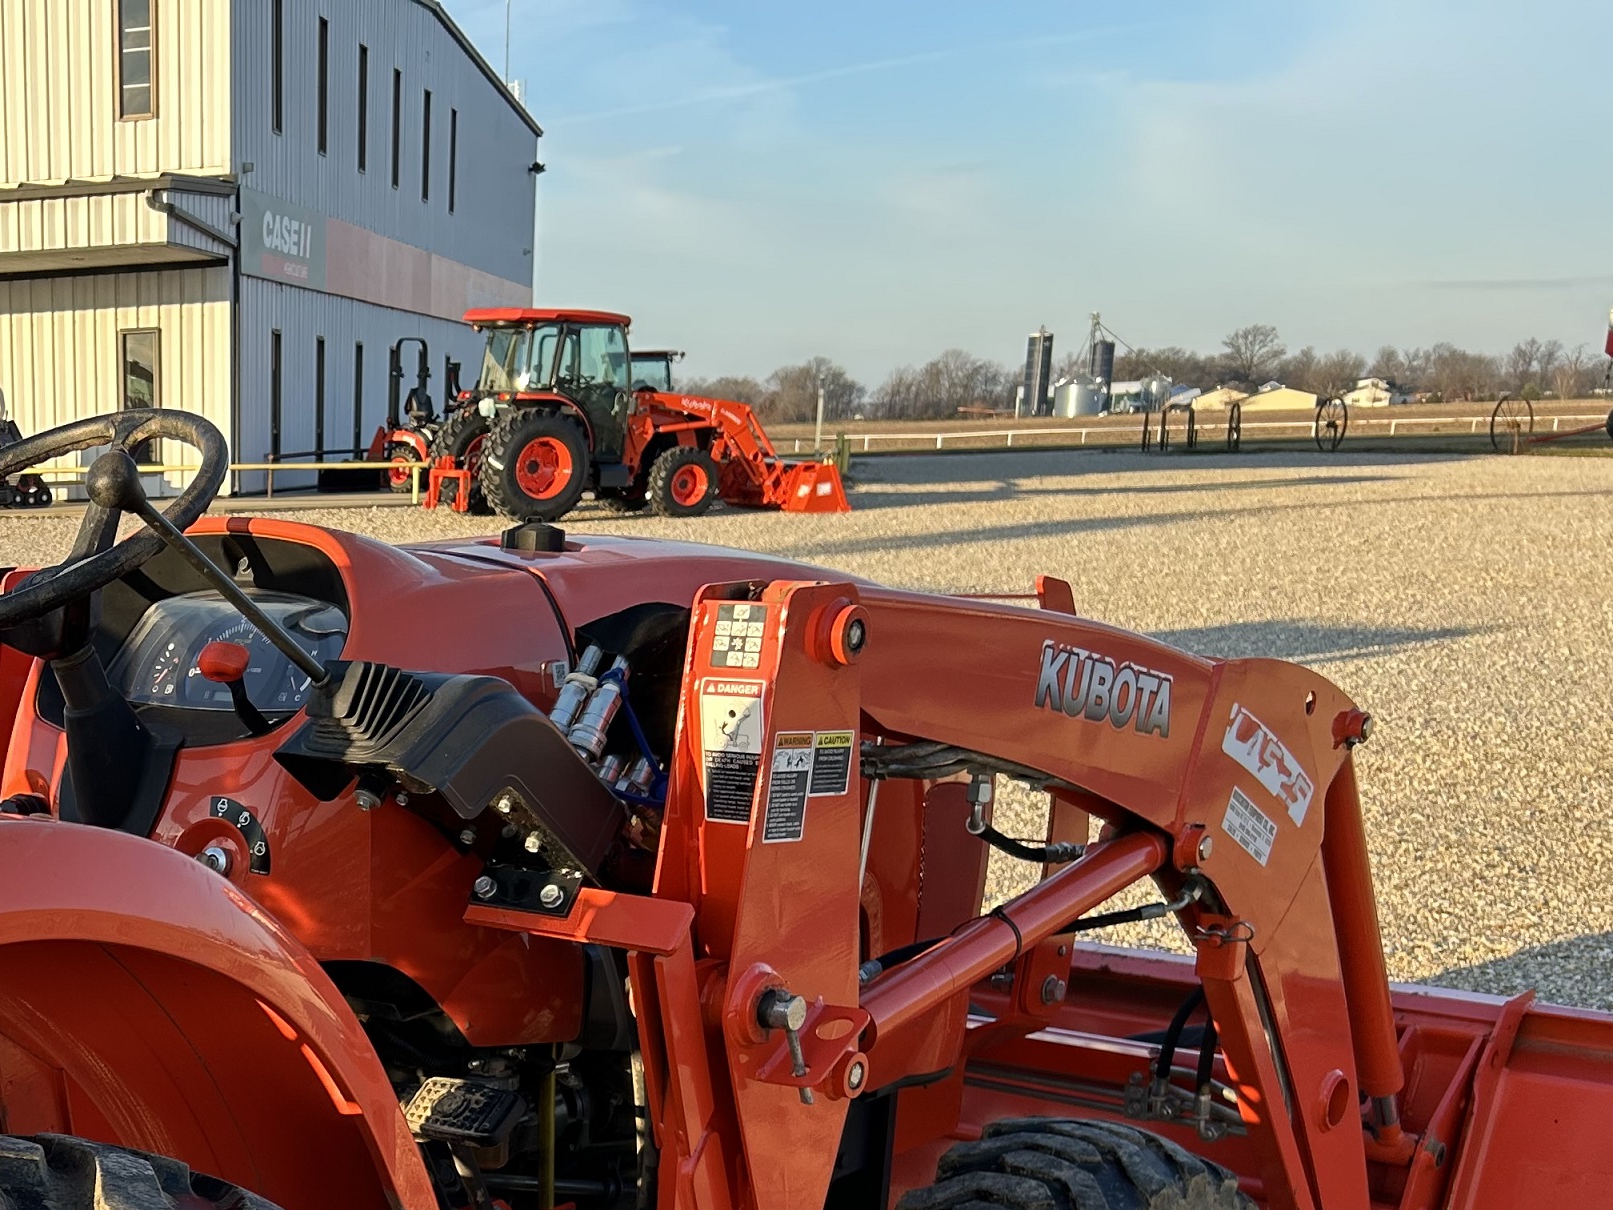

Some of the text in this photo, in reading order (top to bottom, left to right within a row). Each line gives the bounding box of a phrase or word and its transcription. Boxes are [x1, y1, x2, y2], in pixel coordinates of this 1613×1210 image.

[262, 209, 300, 255] CASE
[717, 683, 759, 695] DANGER
[1034, 641, 1173, 738] KUBOTA
[784, 735, 811, 746] WARNING
[823, 735, 850, 745] CAUTION
